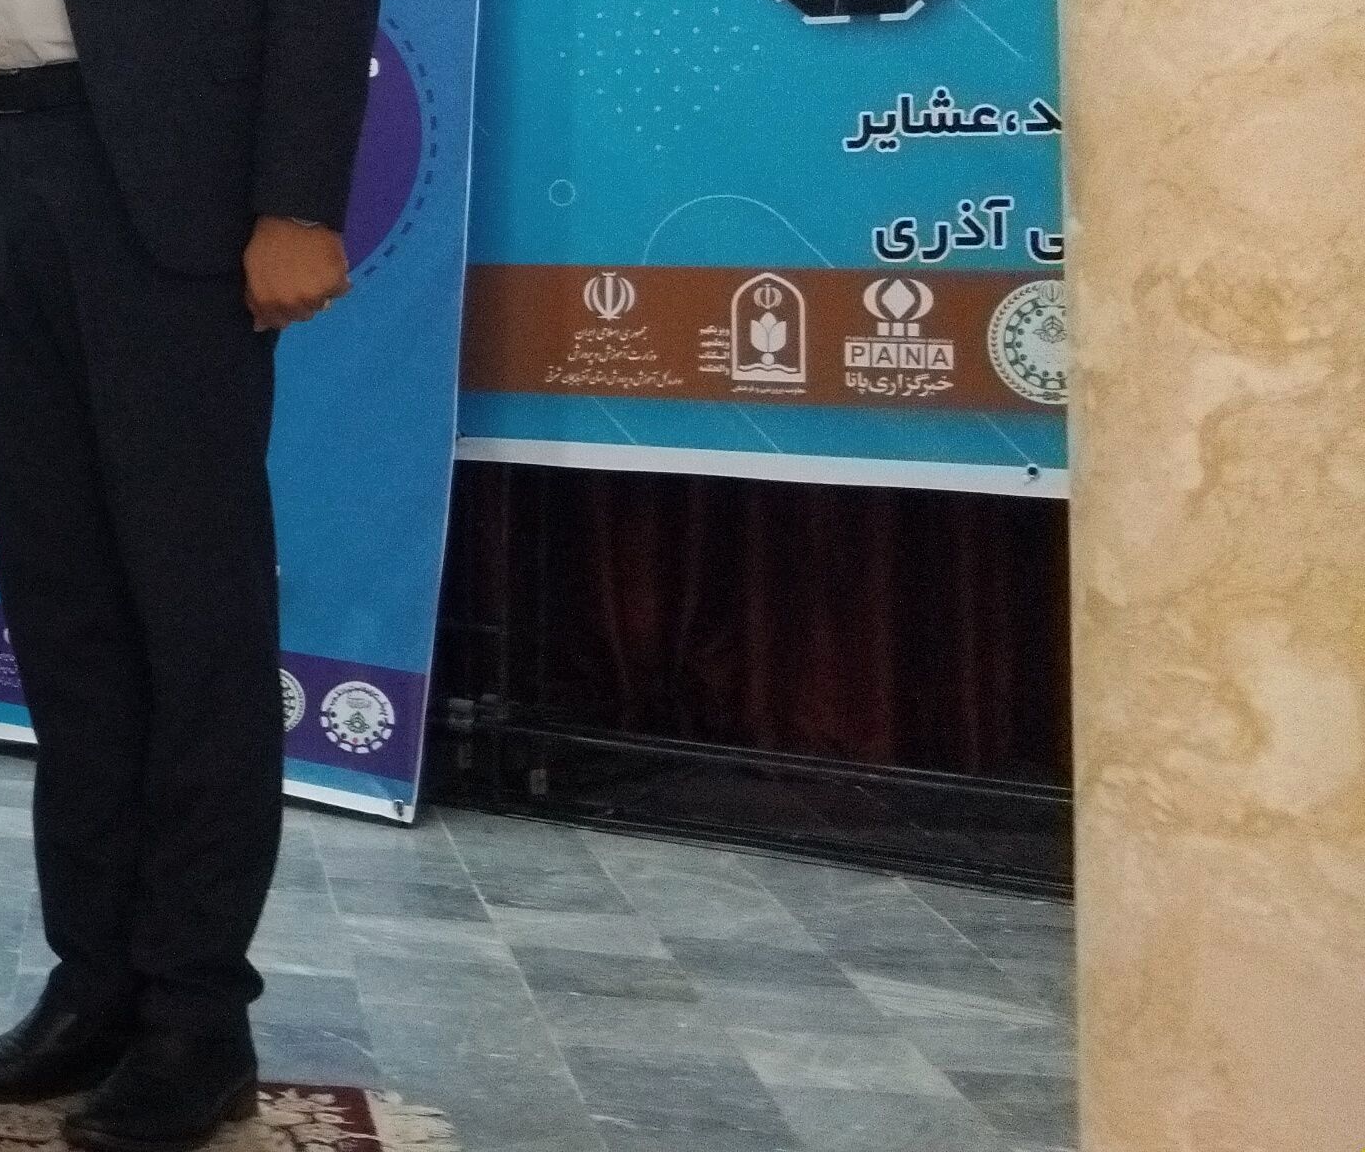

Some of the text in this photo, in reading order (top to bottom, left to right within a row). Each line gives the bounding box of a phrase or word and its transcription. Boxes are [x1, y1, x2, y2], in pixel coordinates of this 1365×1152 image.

[844, 86, 1062, 152] د،عشایر
[873, 195, 1014, 261] آذری
[848, 344, 952, 368] PANA
